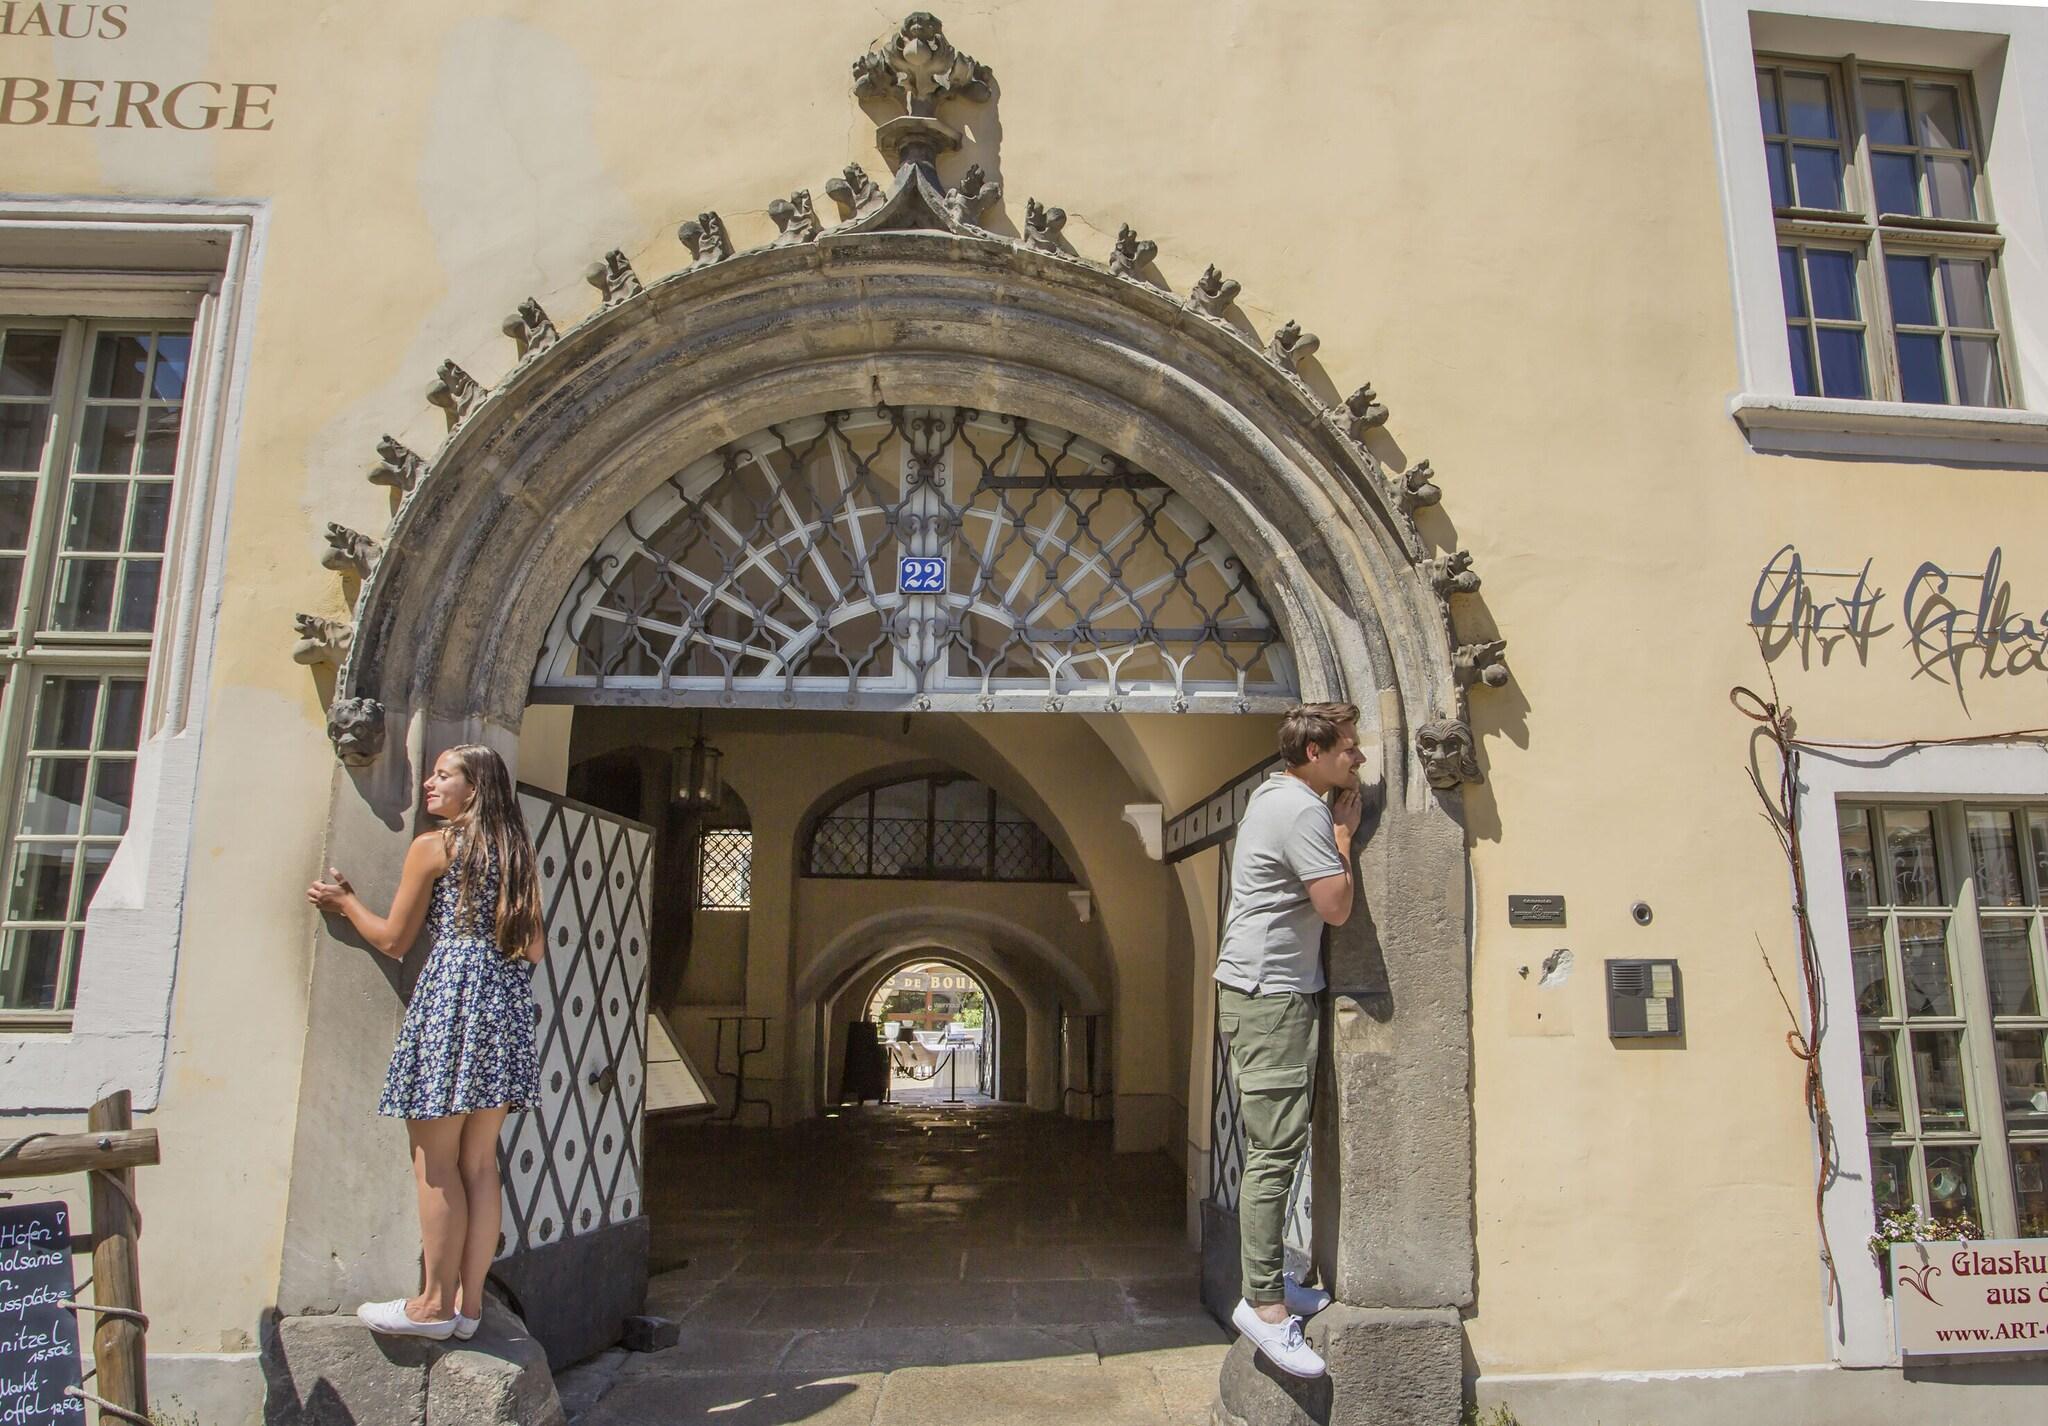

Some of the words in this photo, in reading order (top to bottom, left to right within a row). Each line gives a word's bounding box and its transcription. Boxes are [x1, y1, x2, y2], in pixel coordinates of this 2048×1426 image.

[0, 77, 278, 131] BERGE
[904, 561, 942, 588] 22
[1750, 543, 1887, 638] Art
[904, 978, 921, 987] DE
[1986, 1287, 2030, 1305] aus
[1936, 1321, 2048, 1342] www.ART-
[0, 1391, 49, 1426] offel
